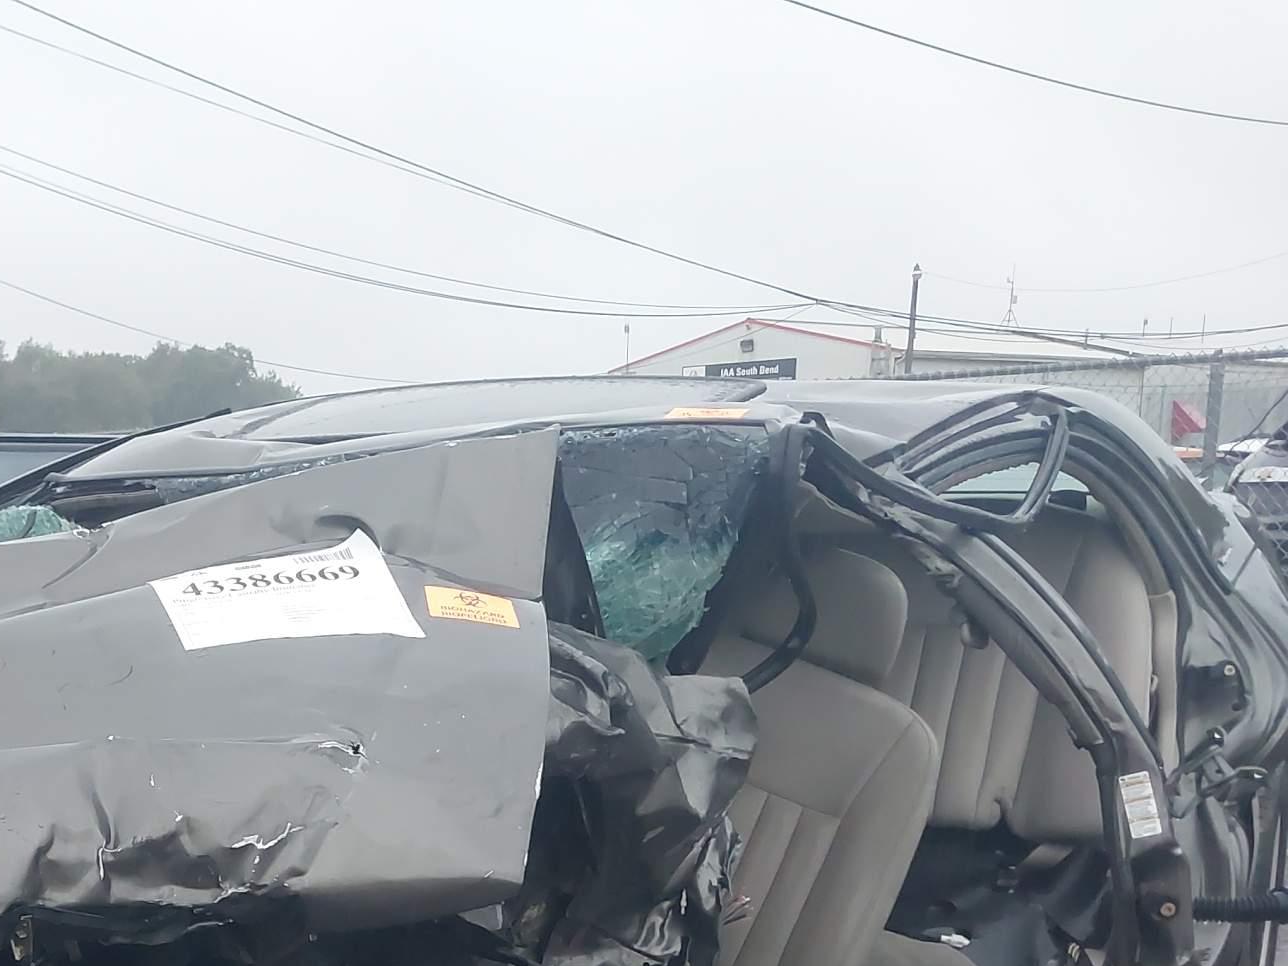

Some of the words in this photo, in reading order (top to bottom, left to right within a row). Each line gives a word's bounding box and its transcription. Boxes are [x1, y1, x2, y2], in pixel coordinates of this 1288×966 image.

[720, 367, 735, 377] IAA
[736, 365, 758, 376] South
[759, 363, 779, 375] Bend
[182, 565, 360, 596] 43386669
